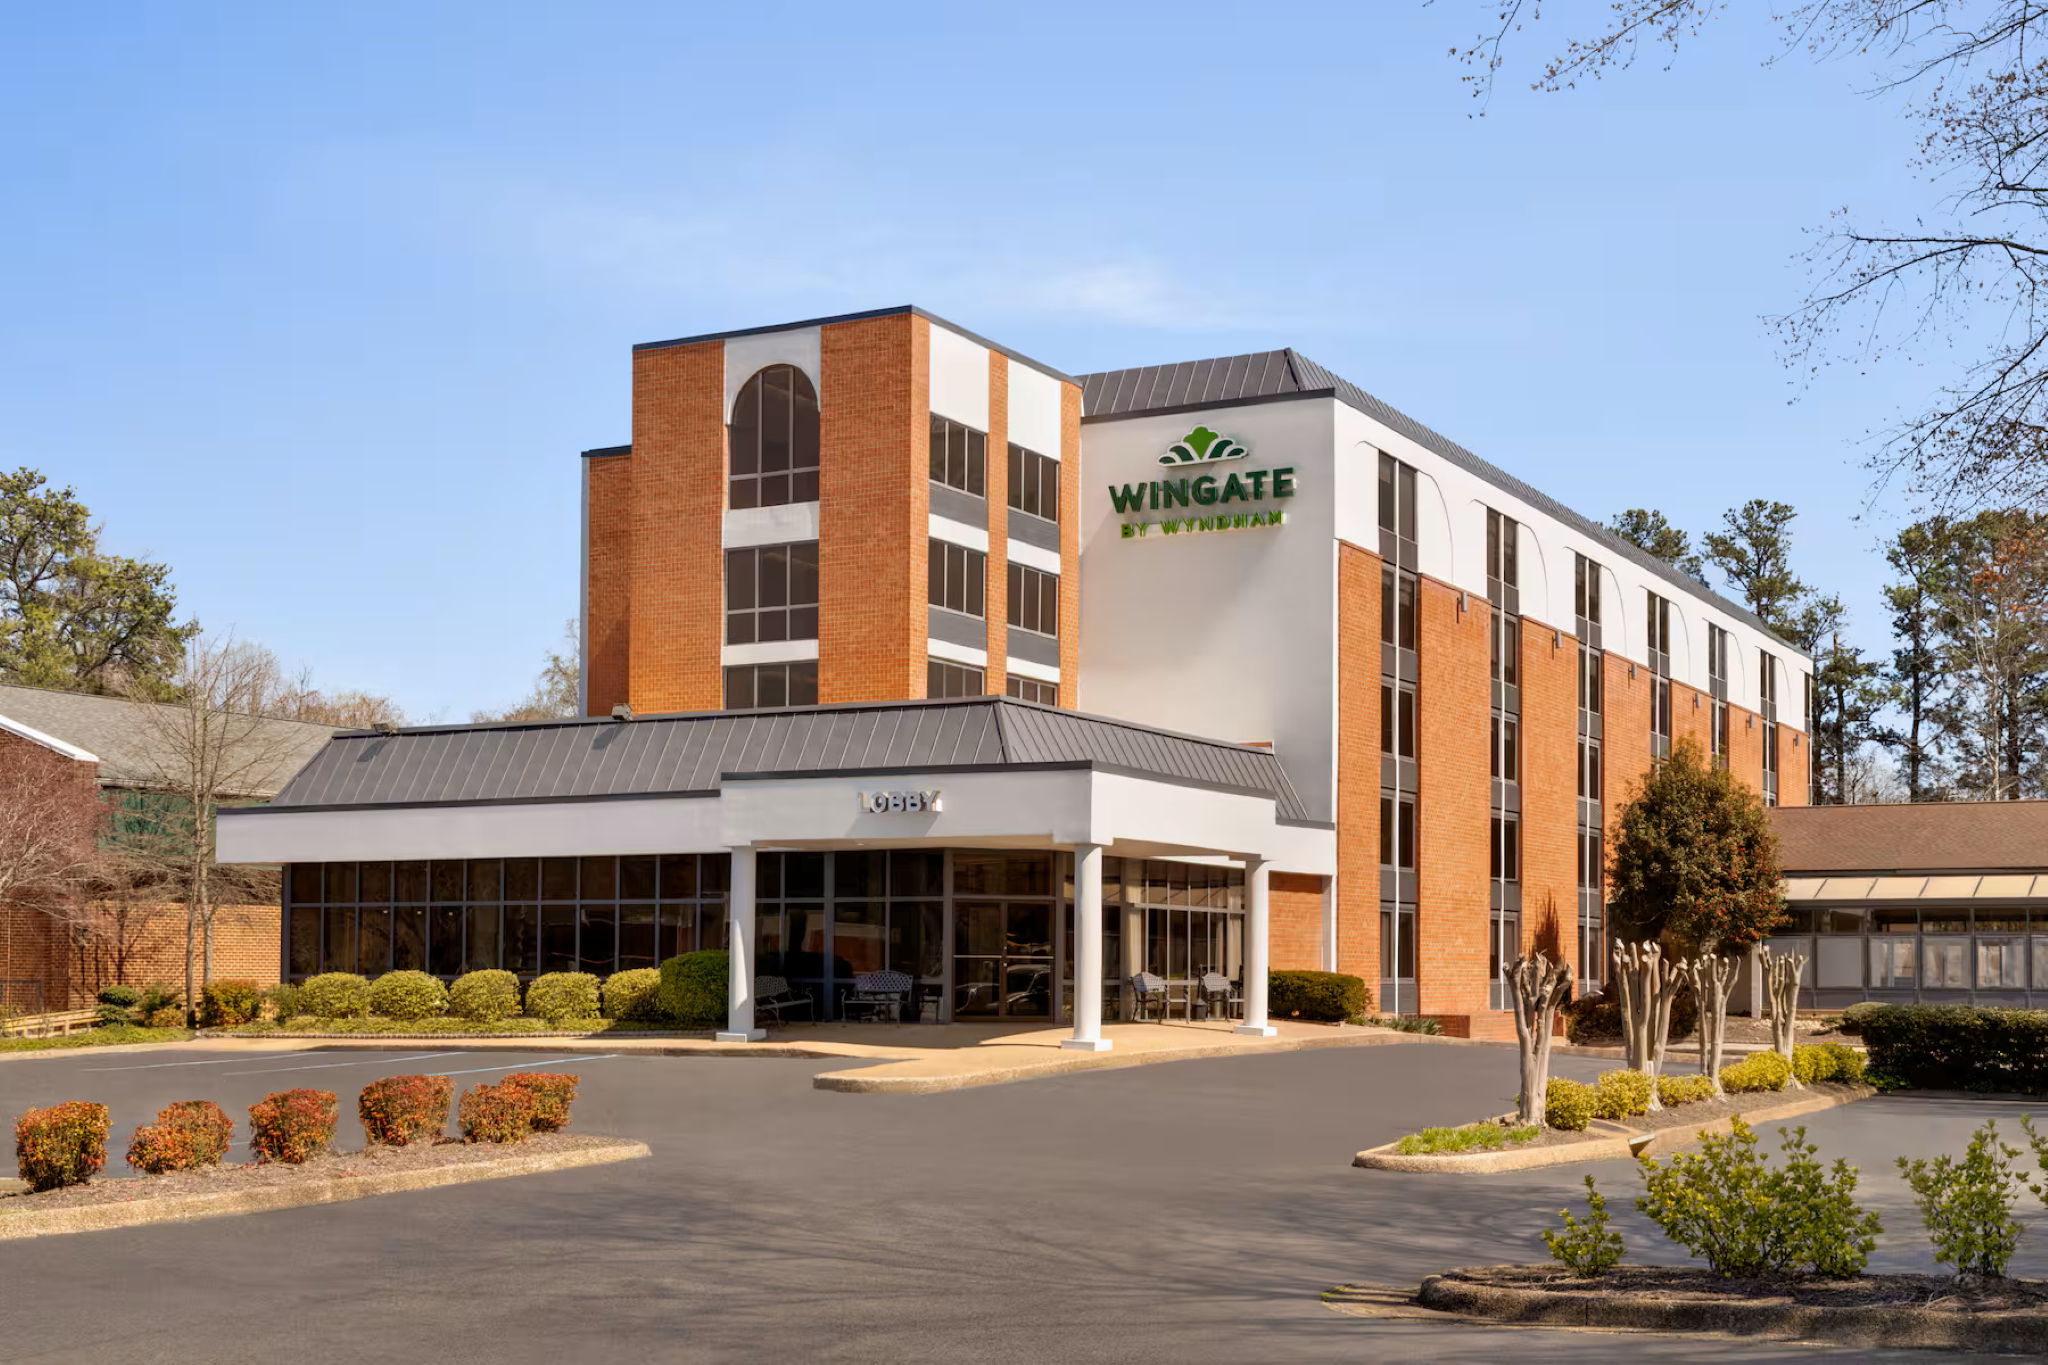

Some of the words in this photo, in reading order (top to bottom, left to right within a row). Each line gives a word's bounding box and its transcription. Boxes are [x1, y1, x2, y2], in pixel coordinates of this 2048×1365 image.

[1108, 467, 1295, 514] WINGATE
[1121, 522, 1149, 539] BY
[1160, 510, 1284, 535] WYNDHAM
[858, 790, 942, 813] LOBBY
